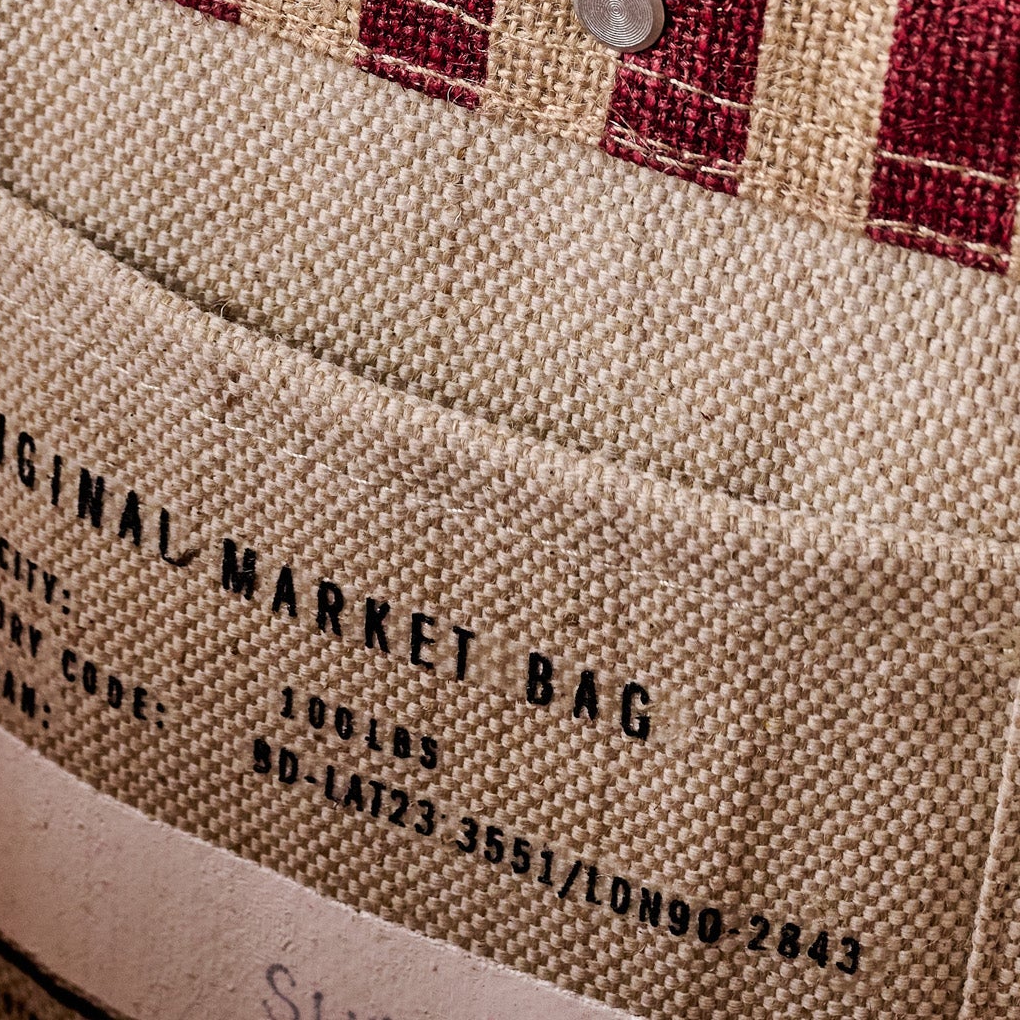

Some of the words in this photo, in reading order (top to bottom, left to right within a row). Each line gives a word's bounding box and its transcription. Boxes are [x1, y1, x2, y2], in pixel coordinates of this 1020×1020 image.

[222, 537, 475, 681] MARKET
[526, 652, 651, 742] BAG
[61, 647, 167, 730] CODE:
[280, 686, 439, 770] 100LBS
